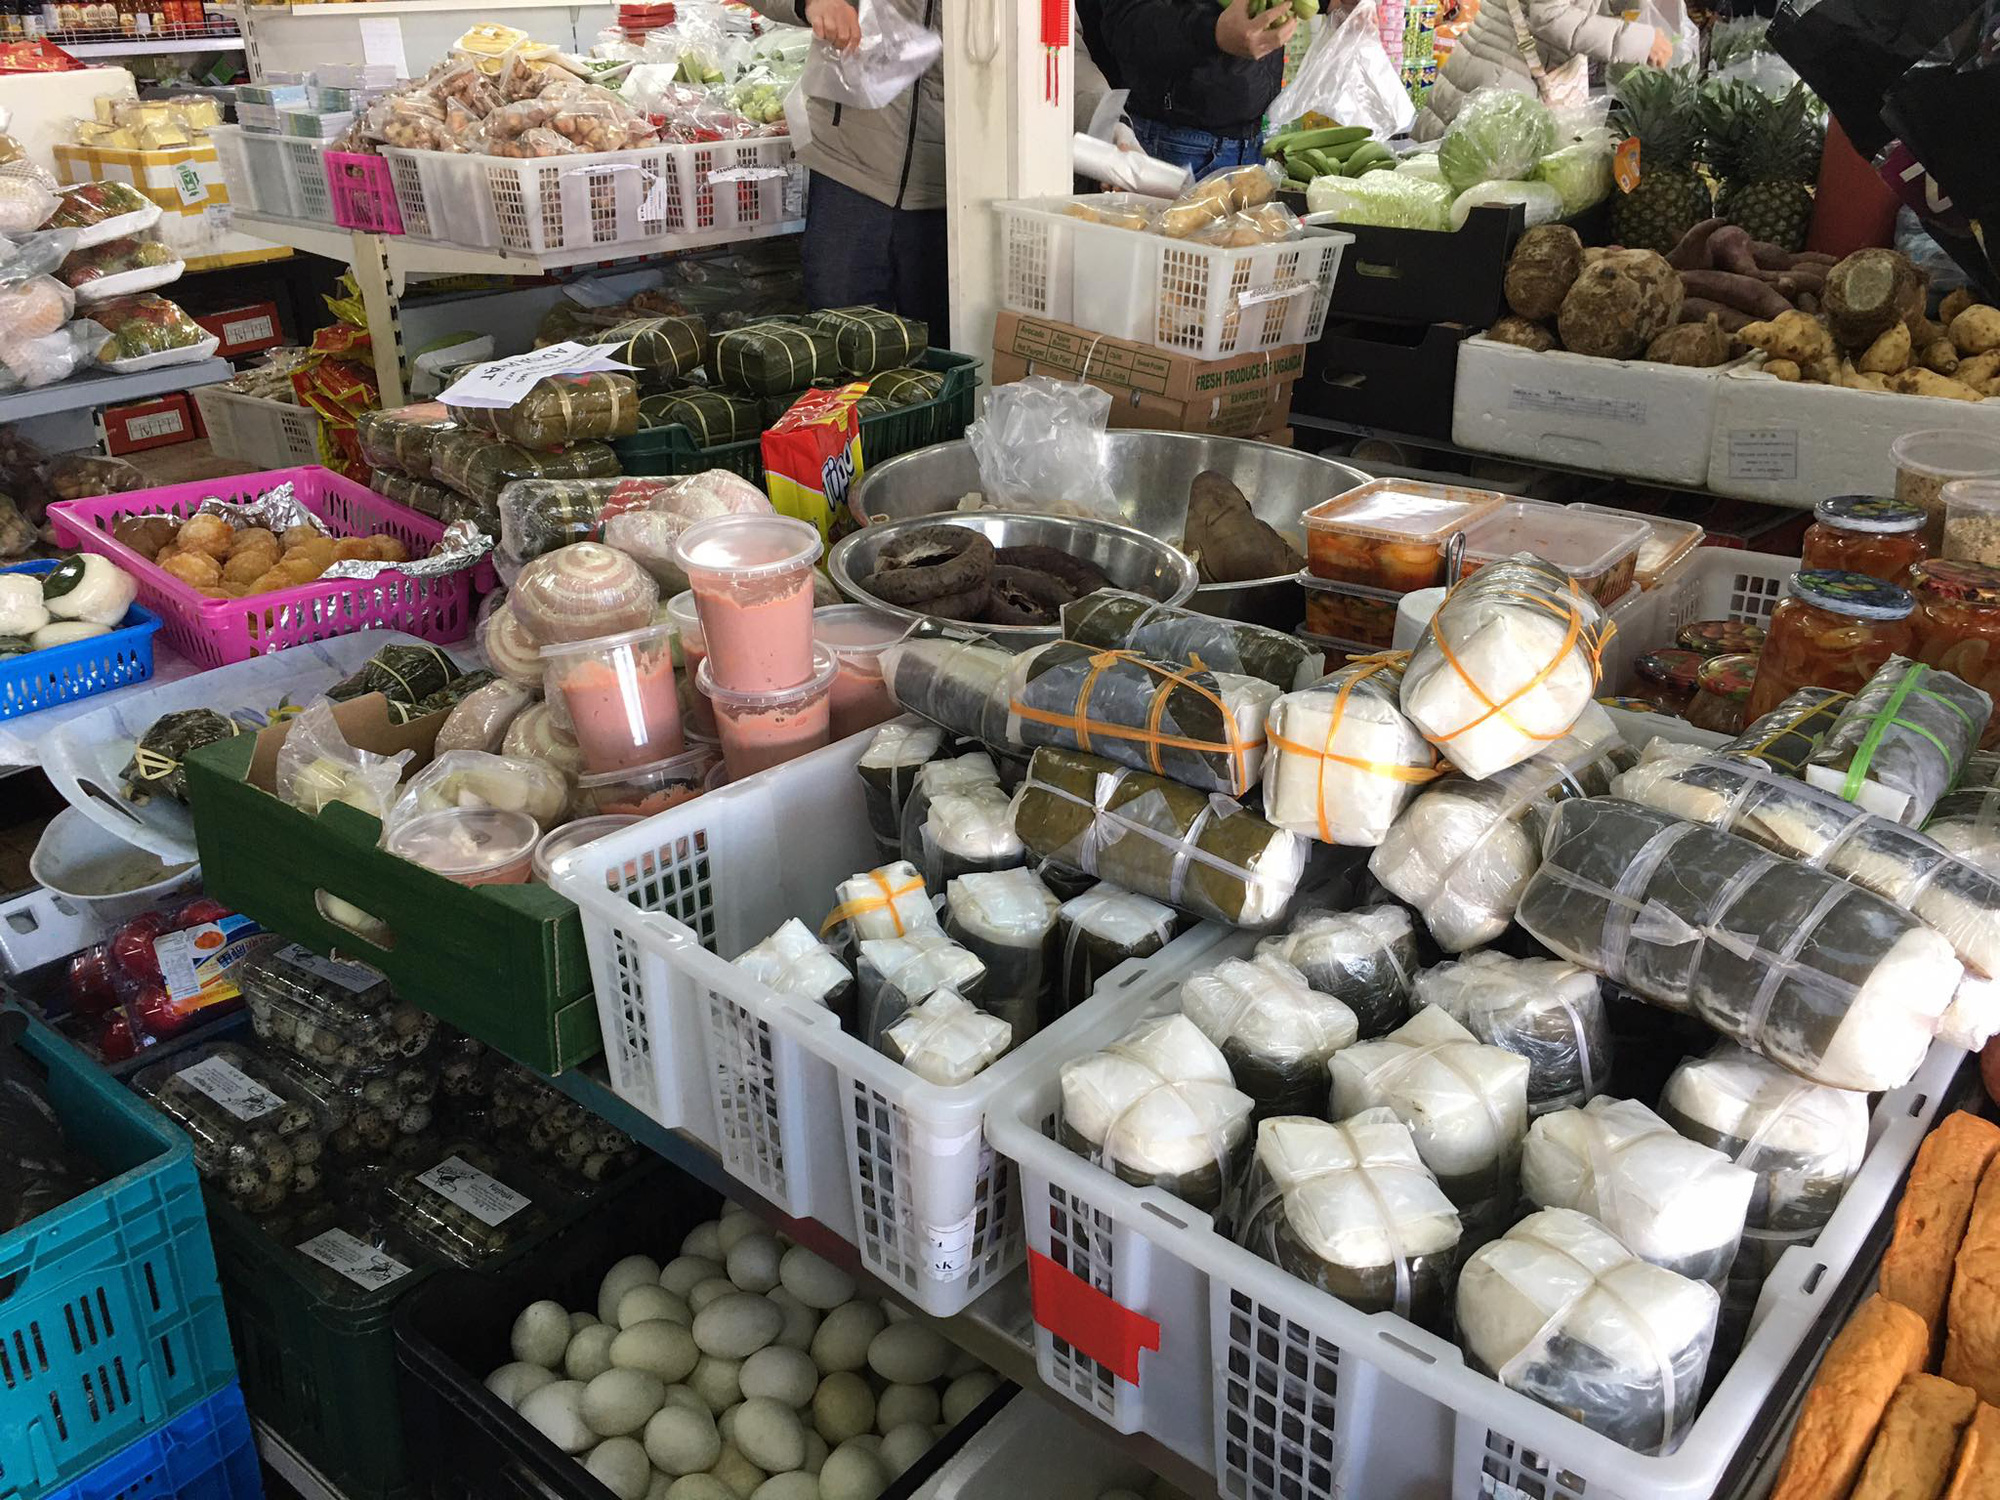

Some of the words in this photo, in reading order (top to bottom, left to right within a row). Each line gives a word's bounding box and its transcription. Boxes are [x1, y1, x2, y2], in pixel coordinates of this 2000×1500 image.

[1195, 372, 1222, 391] FRESH
[1224, 364, 1261, 386] PRODUCE
[1262, 361, 1272, 377] OF
